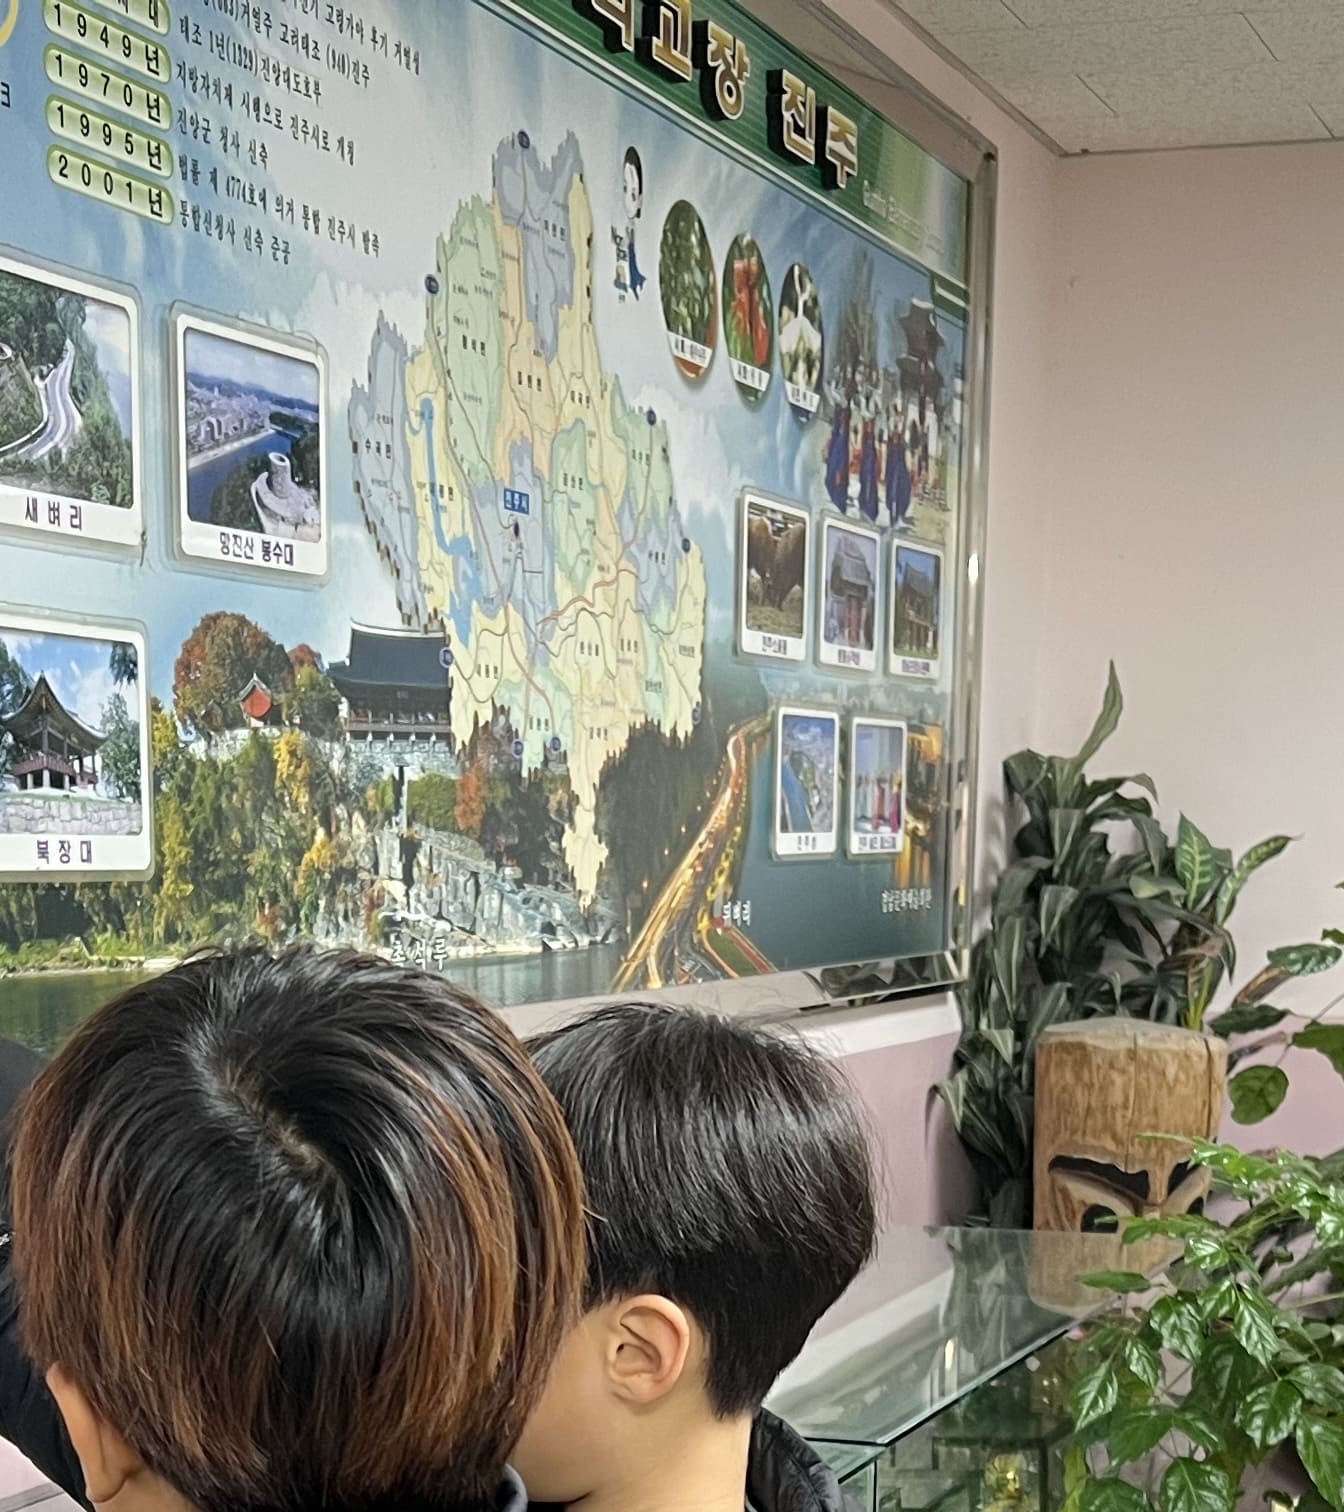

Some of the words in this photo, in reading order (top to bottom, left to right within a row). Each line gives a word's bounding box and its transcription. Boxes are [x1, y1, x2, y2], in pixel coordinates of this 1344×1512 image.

[53, 3, 160, 76] 1949년
[55, 54, 161, 123] 1970년
[176, 61, 233, 110] 지방자치제
[289, 115, 331, 152] 진주시로
[57, 104, 162, 170] 1995년
[176, 107, 211, 145] 진양군
[781, 67, 858, 190] 진주
[58, 155, 163, 218] 2001년
[178, 199, 236, 246] 통합신청사
[327, 215, 357, 249] 진주시
[24, 496, 83, 532] 새벼리
[218, 531, 255, 561] 망진산
[261, 538, 295, 567] 봉수대
[36, 840, 93, 866] 북장대
